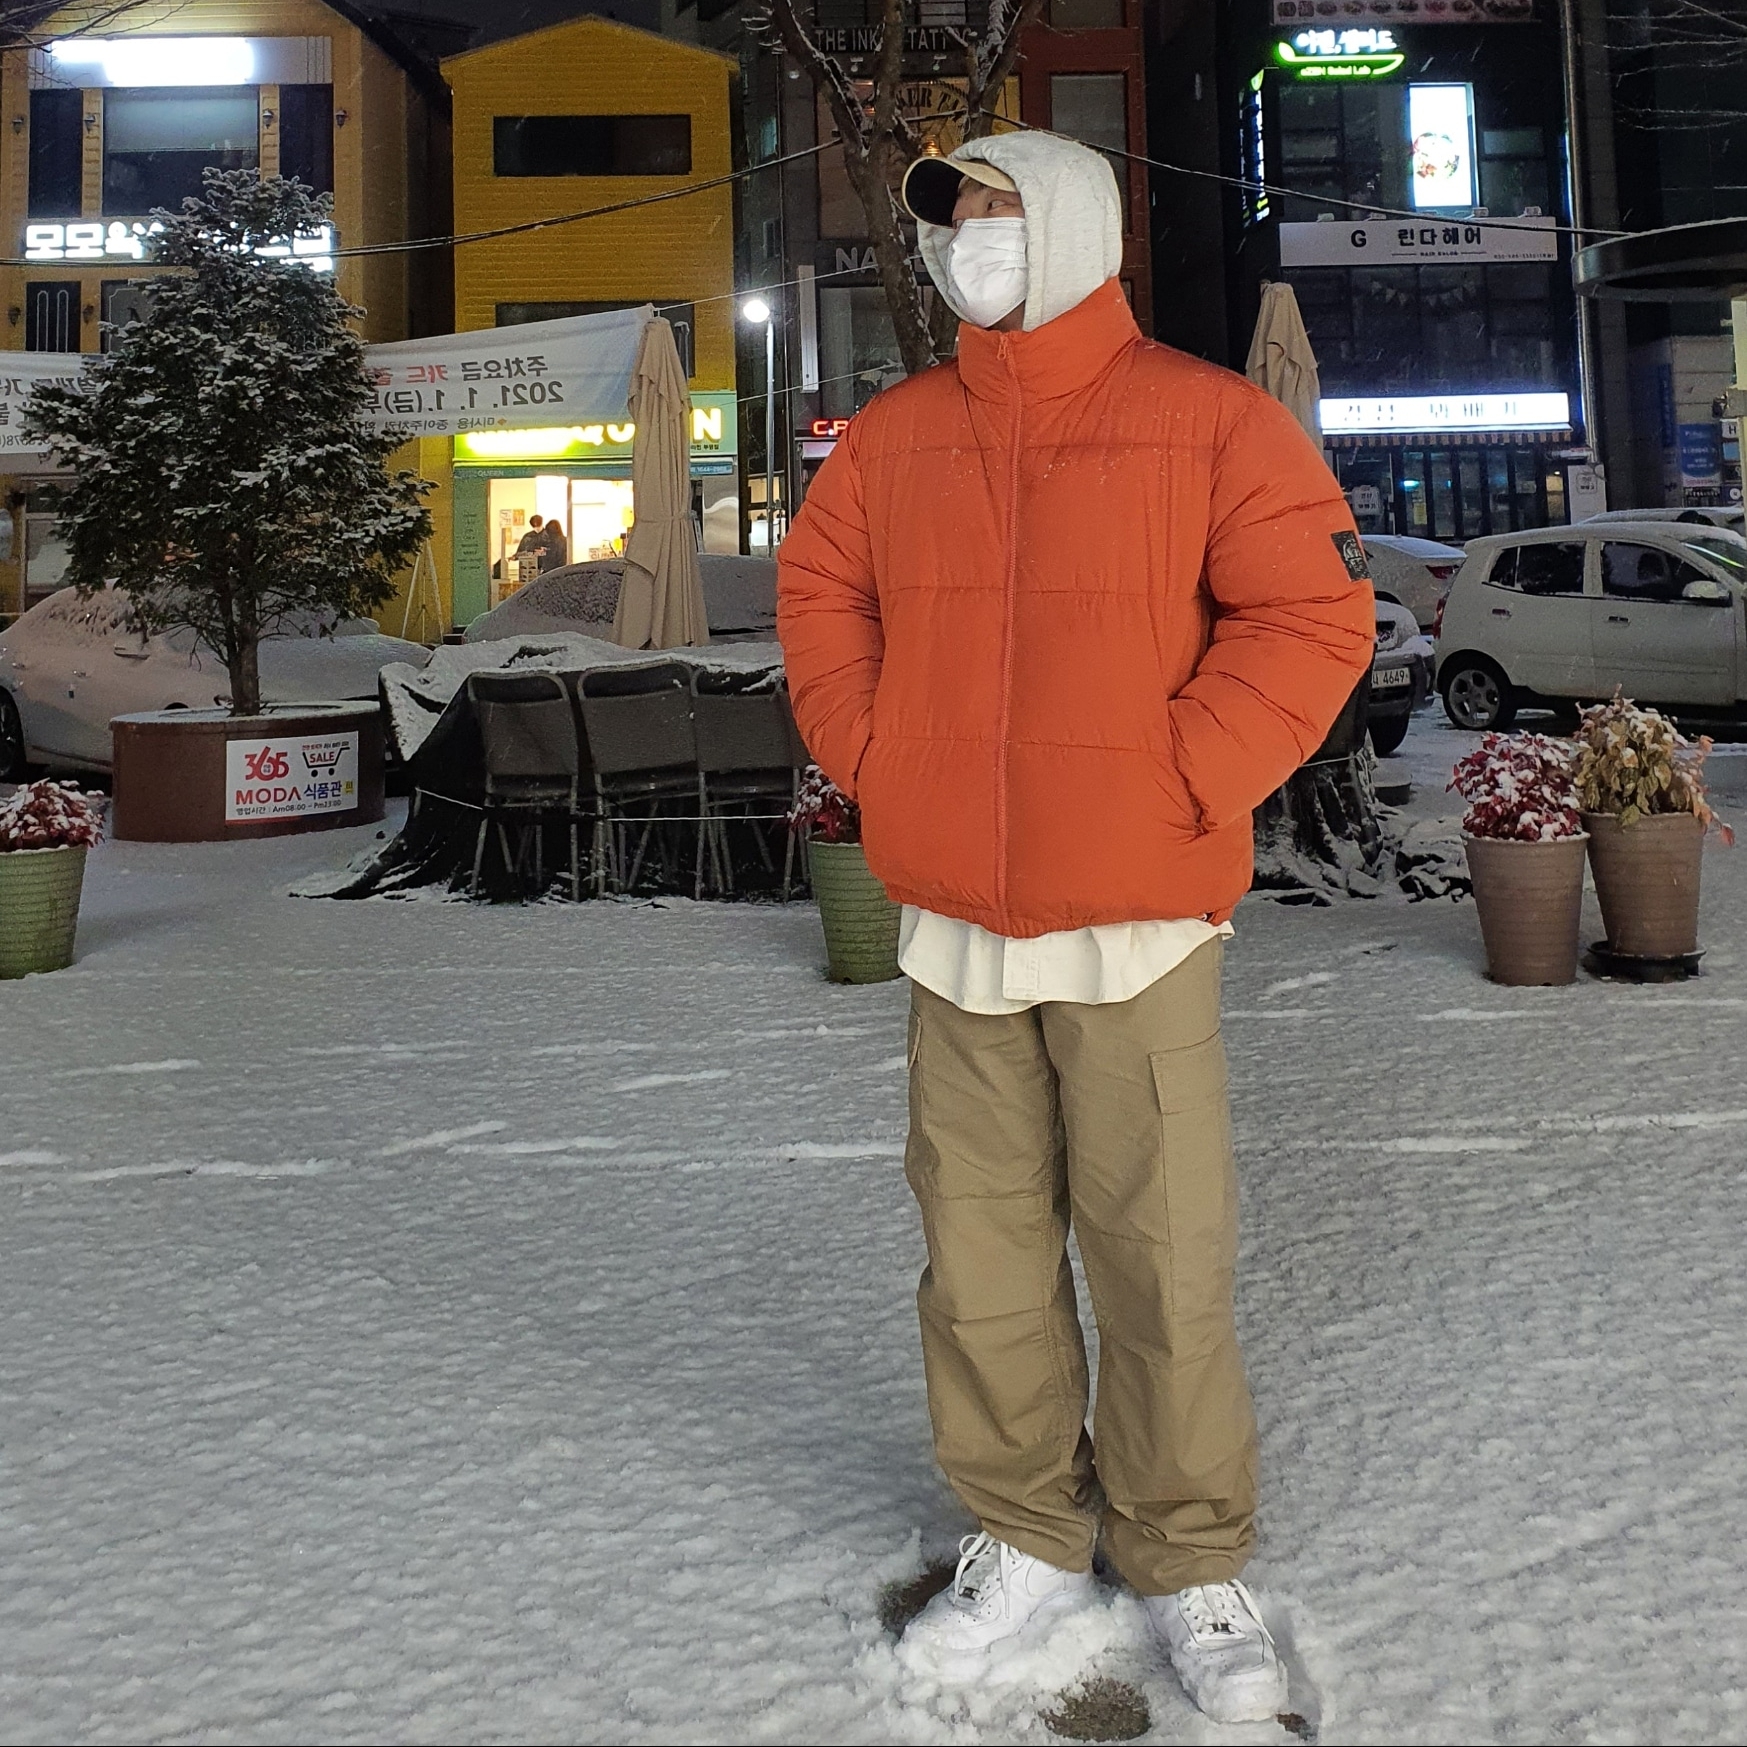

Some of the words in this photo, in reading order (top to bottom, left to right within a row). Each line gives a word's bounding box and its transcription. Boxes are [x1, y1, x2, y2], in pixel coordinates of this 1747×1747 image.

[815, 29, 847, 51] THE
[1350, 229, 1367, 248] G
[1399, 227, 1482, 247] 린다헤어
[1383, 667, 1405, 684] 4649
[244, 745, 290, 781] 365
[309, 751, 335, 764] SALE
[235, 786, 302, 805] MODA
[303, 780, 342, 800] 식품관
